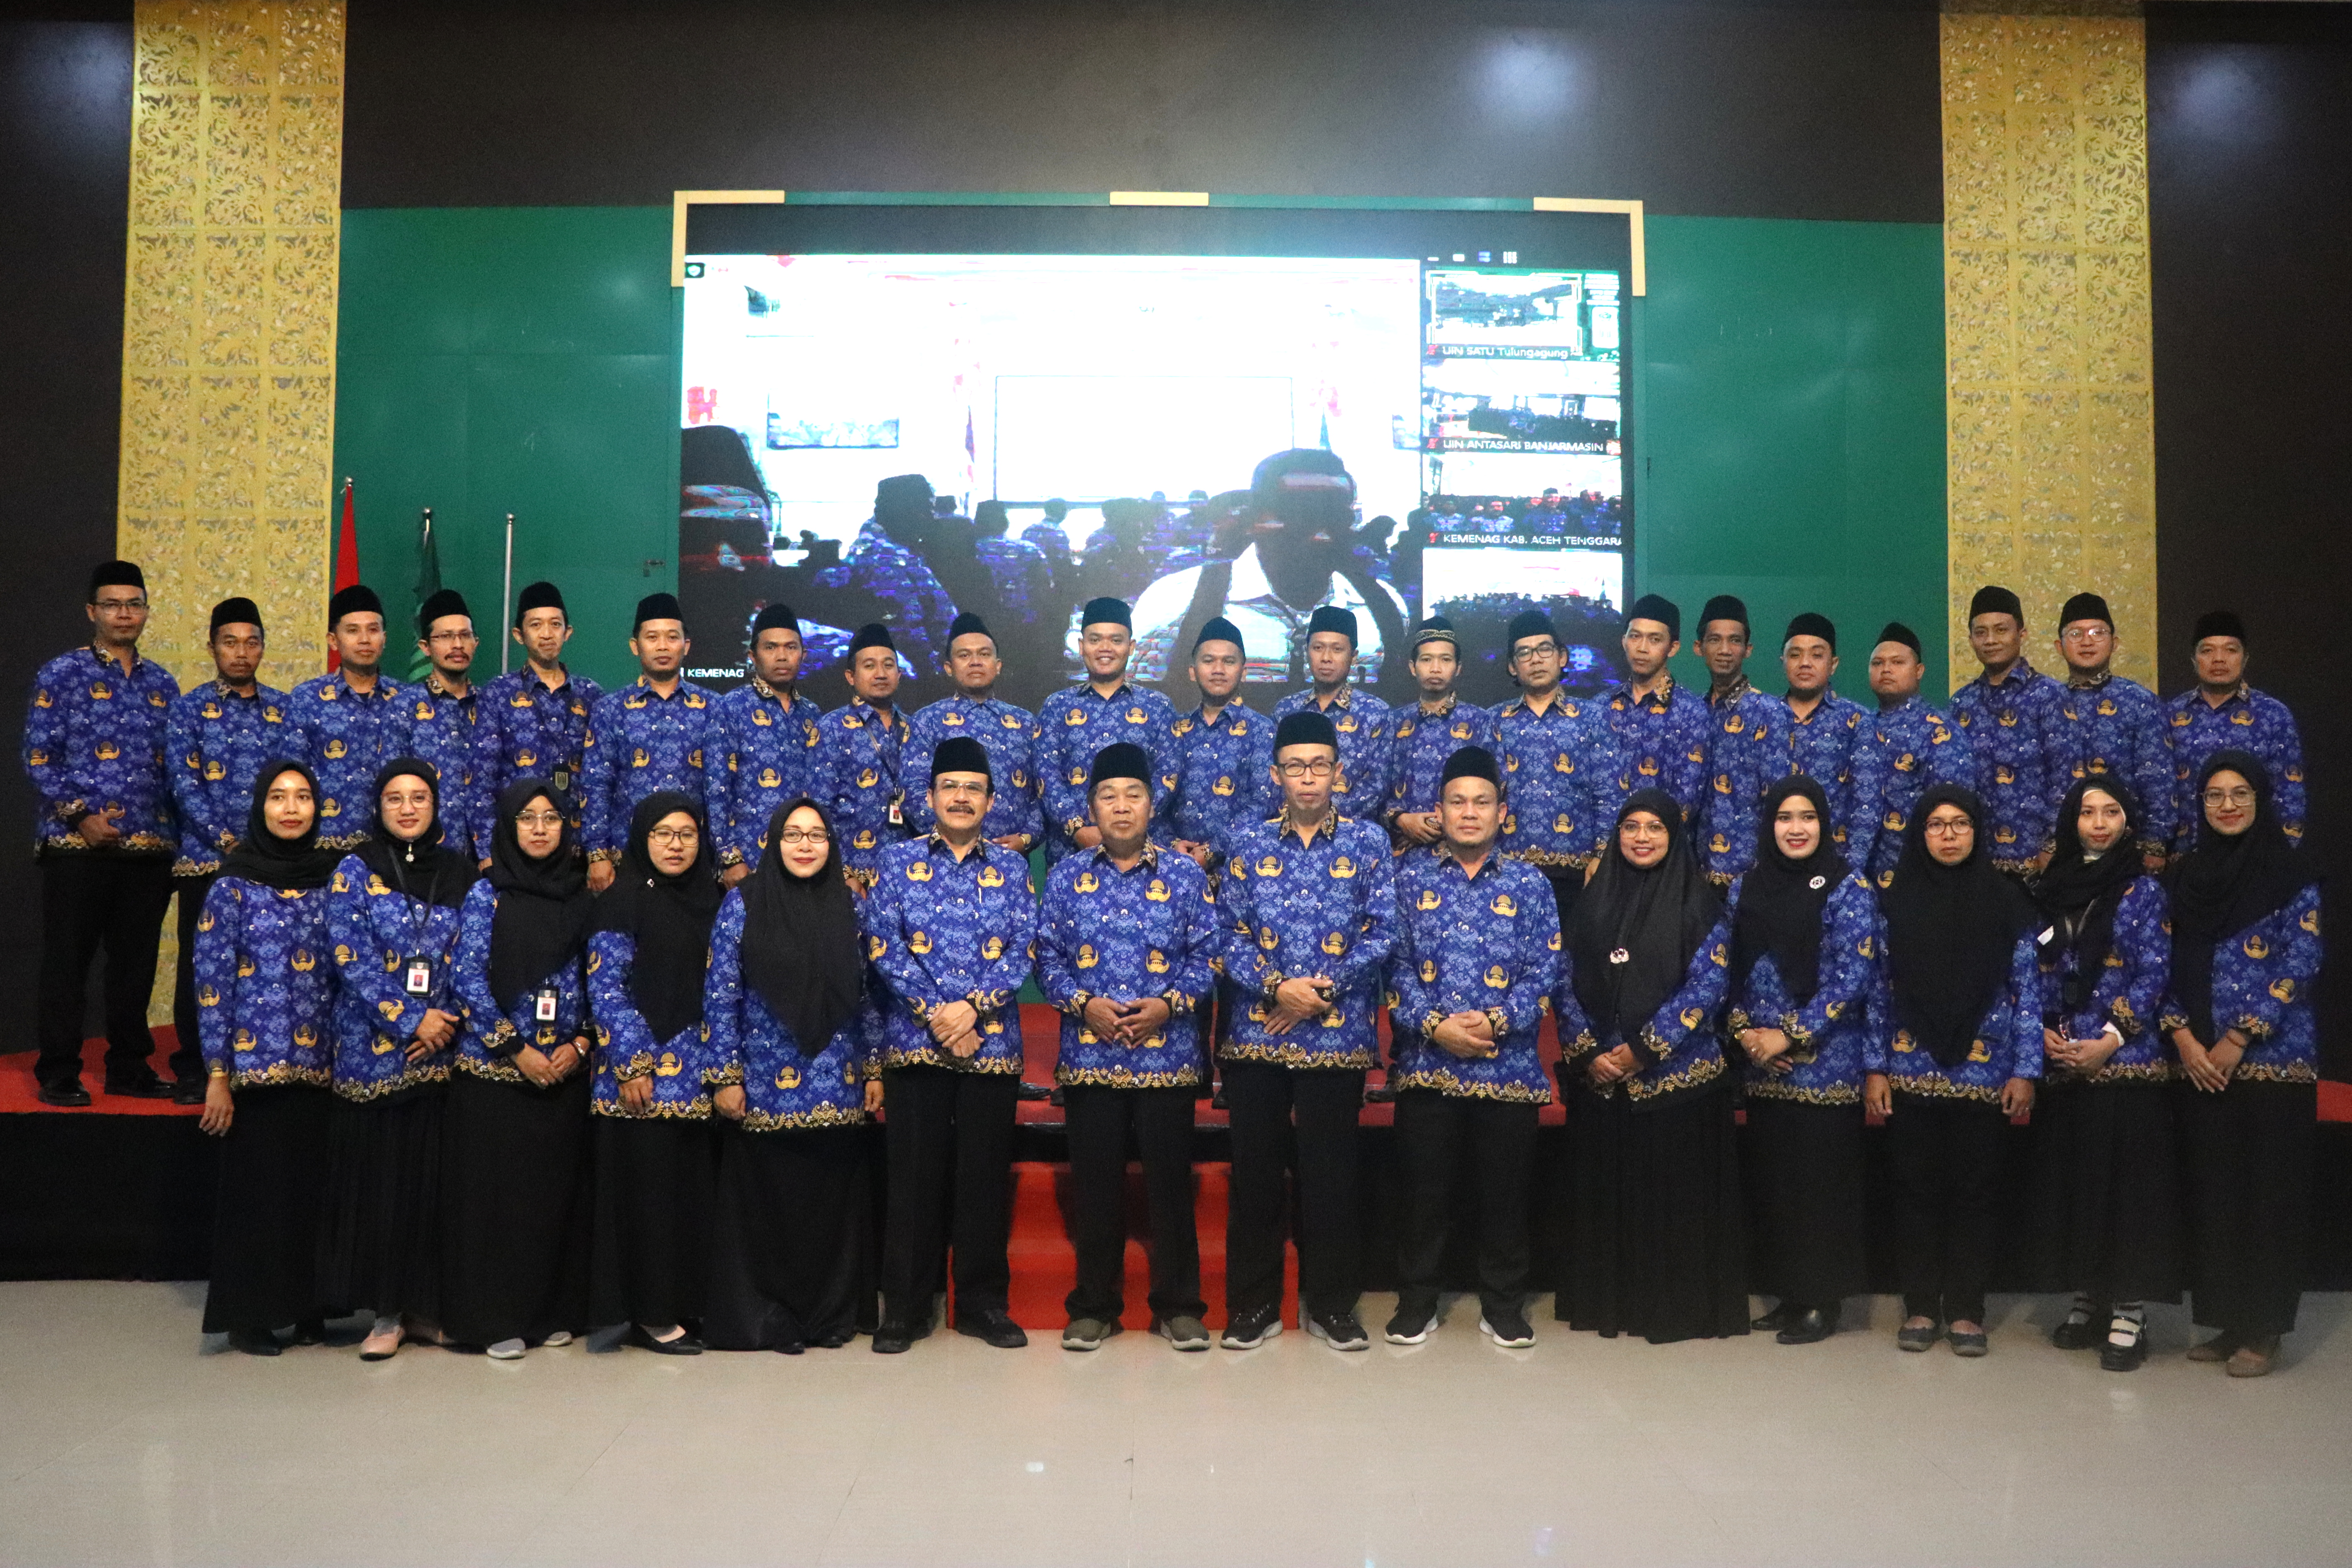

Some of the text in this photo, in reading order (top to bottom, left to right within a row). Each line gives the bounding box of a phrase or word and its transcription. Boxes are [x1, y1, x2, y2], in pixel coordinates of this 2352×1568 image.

[1442, 346, 1568, 360] UIN SATU Tulungagung
[1467, 440, 1522, 450] ANTASARI
[1524, 441, 1603, 451] BANJARMASIN
[1444, 534, 1500, 543] KEMENAG
[1503, 535, 1527, 544] KAB.
[1531, 535, 1561, 545] ACEH
[687, 668, 745, 678] KEMENAG
